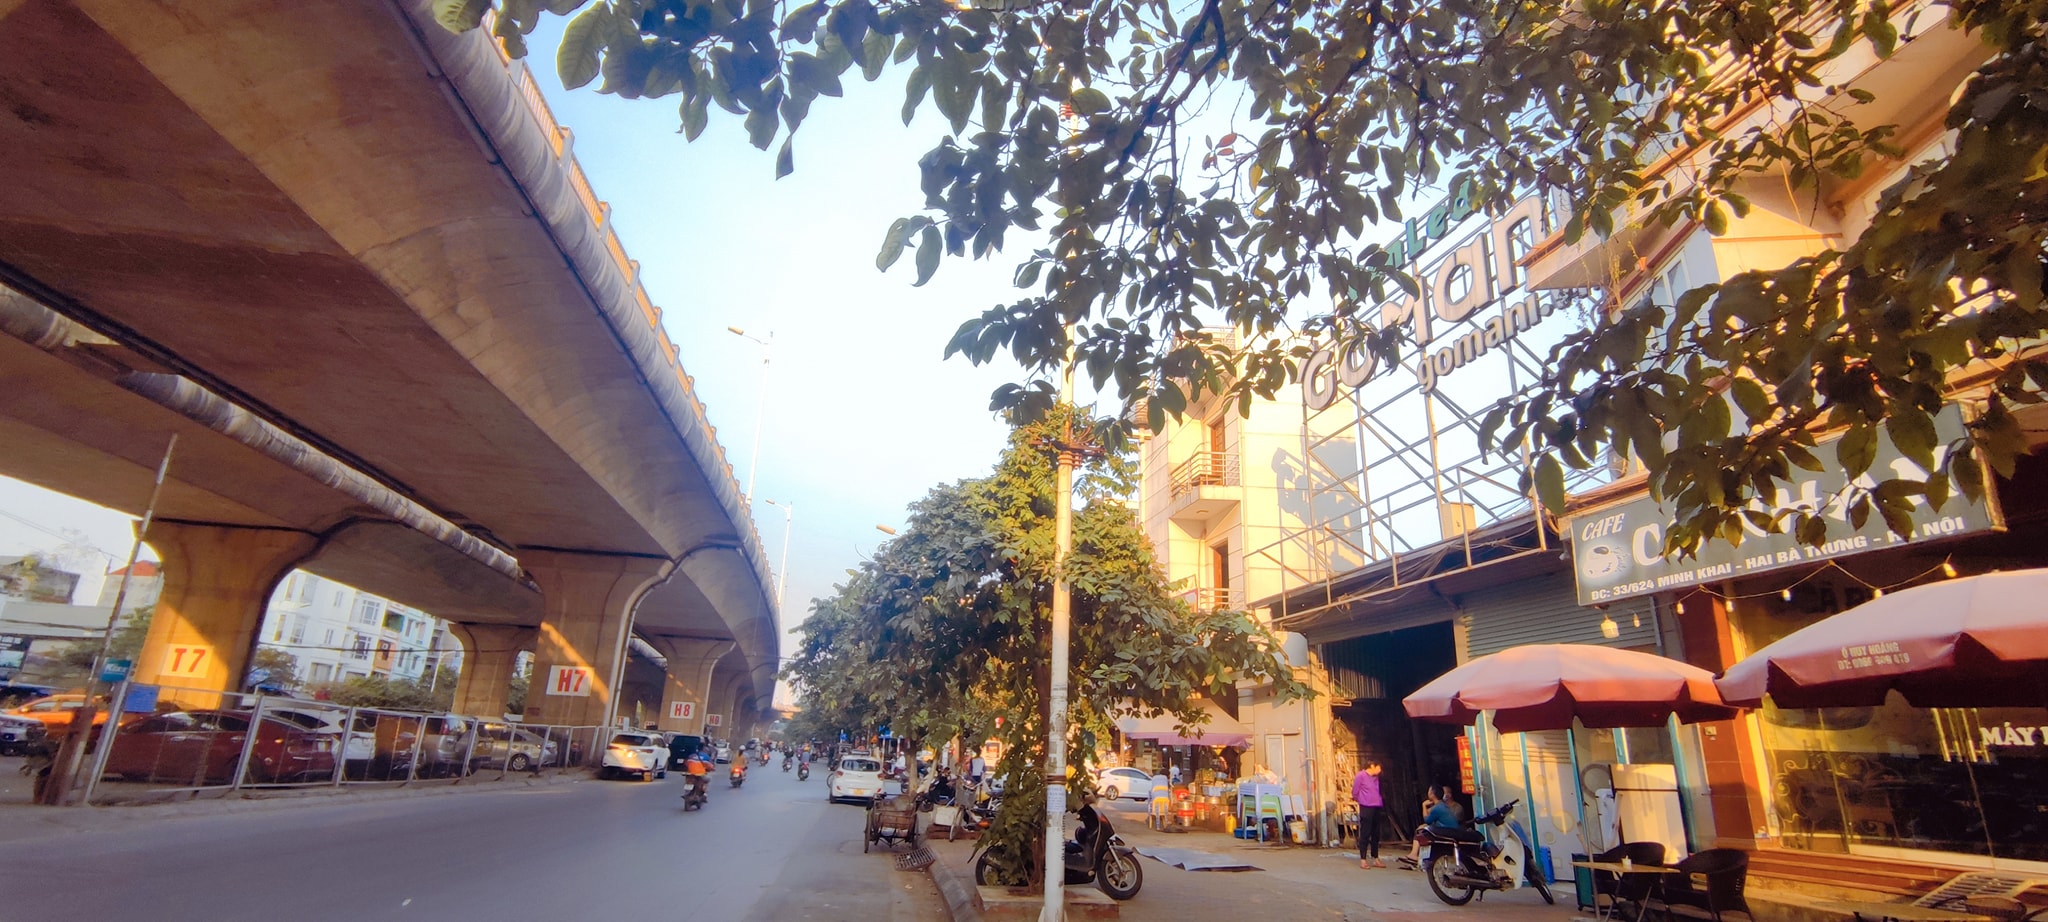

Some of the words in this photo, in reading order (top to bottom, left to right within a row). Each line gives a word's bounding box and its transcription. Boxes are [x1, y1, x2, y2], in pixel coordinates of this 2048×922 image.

[1581, 513, 1625, 542] CAFE
[1612, 579, 1655, 596] 33/624
[1657, 570, 1694, 588] MINH
[1697, 563, 1732, 580] KHAI
[1746, 553, 1773, 570] HAI
[1776, 547, 1801, 563] BÀ
[1922, 516, 1965, 536] NỘI
[171, 648, 206, 673] T7
[557, 669, 587, 692] H7
[674, 703, 691, 717] H8
[1980, 722, 2036, 746] MÁY
